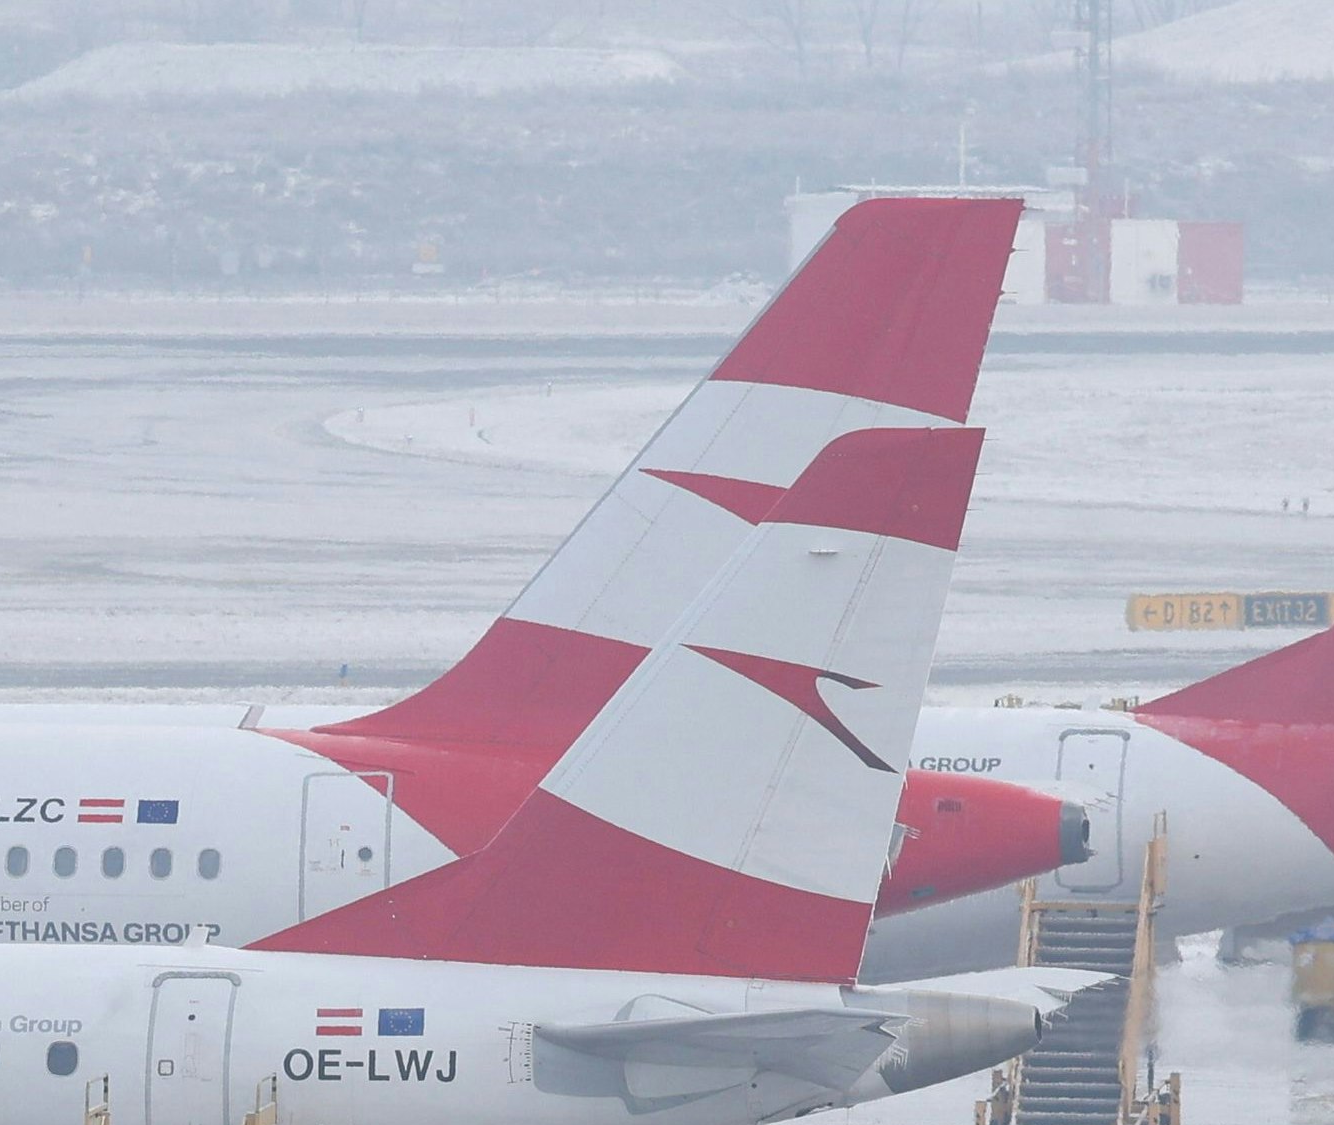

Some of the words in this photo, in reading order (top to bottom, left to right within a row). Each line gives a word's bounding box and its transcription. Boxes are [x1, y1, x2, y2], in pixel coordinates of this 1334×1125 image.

[1163, 601, 1175, 624] D
[1253, 601, 1291, 621] EXIT
[920, 757, 1002, 772] GROUP
[32, 896, 50, 912] of
[9, 1015, 83, 1037] Group
[283, 1048, 457, 1082] OE-LWJ
